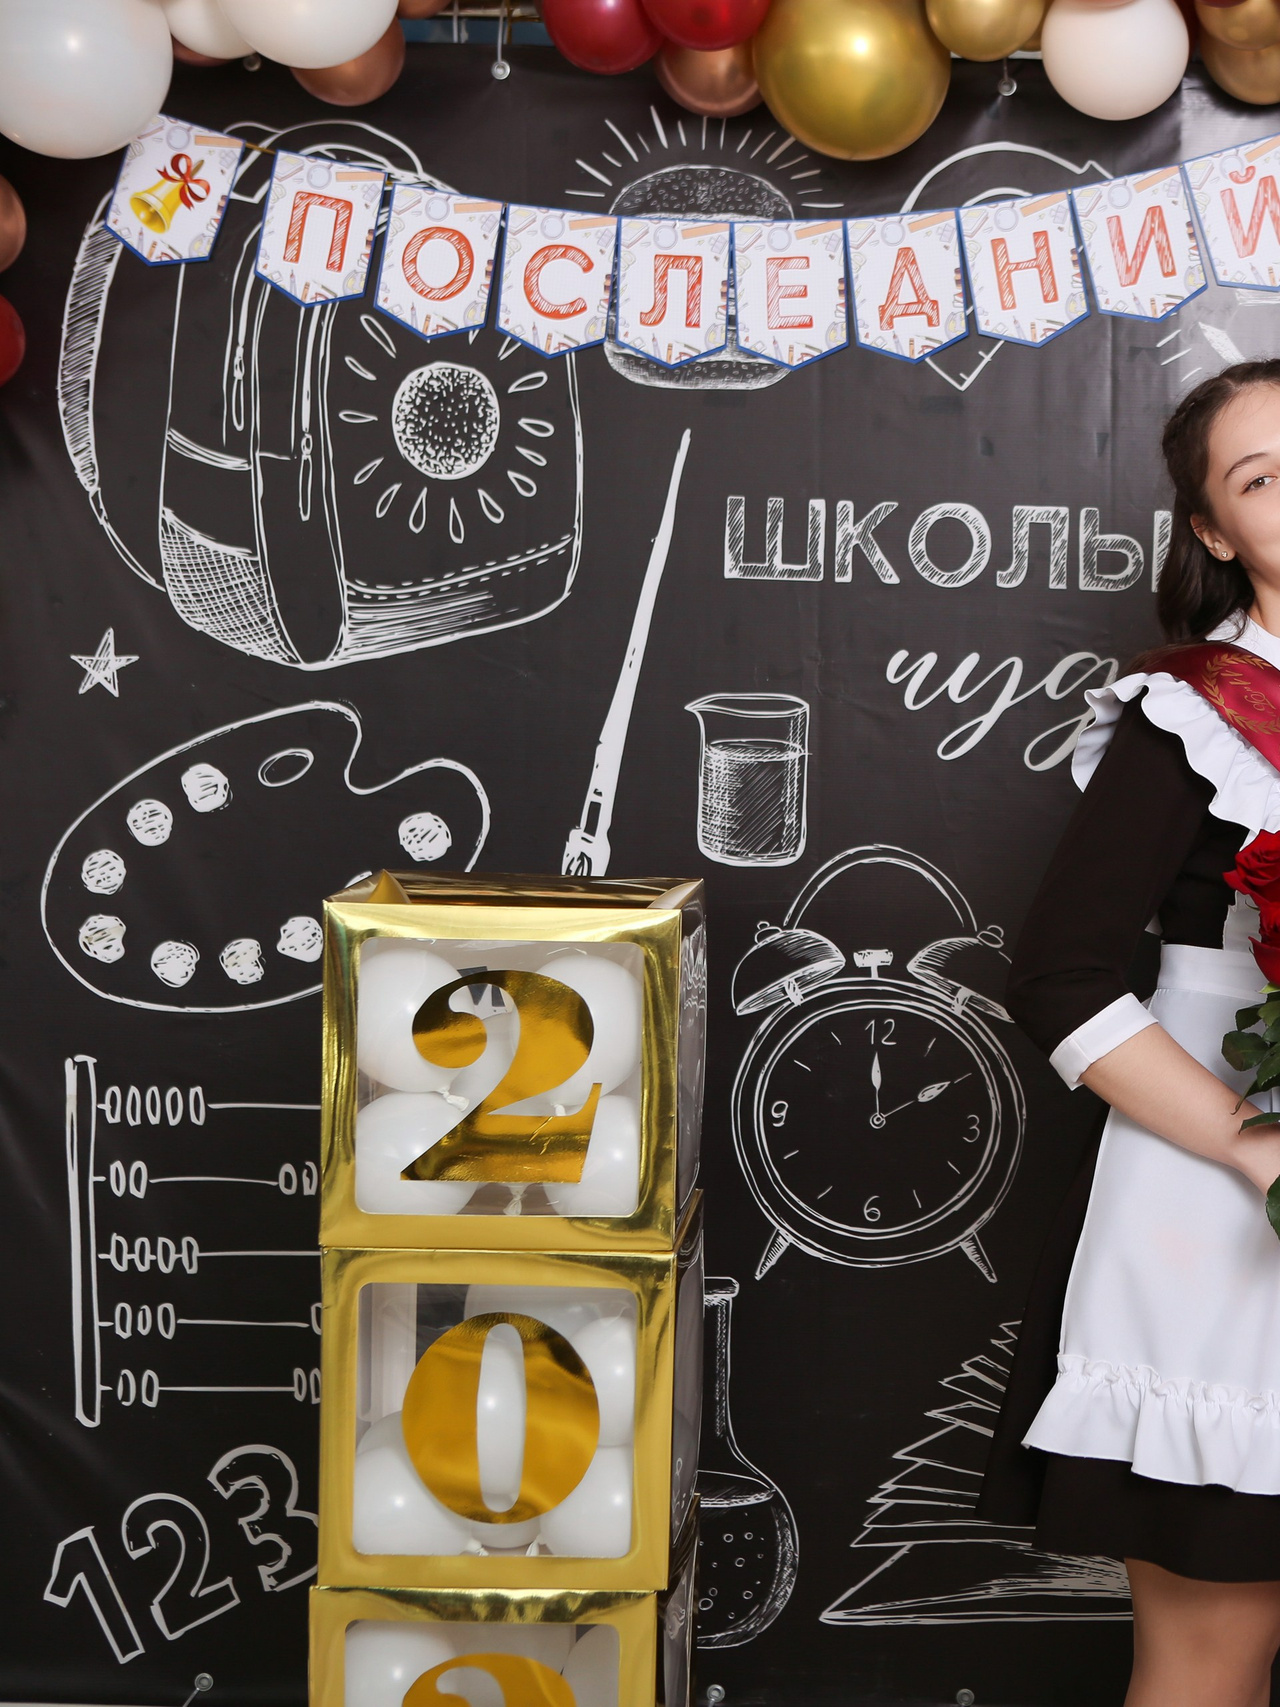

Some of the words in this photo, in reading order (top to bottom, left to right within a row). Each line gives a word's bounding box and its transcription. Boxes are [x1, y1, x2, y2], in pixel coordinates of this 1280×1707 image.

[864, 1019, 897, 1046] 12
[400, 970, 603, 1183] 2
[771, 1100, 789, 1127] 9
[962, 1114, 981, 1143] 3
[863, 1196, 882, 1222] 6
[402, 1311, 600, 1524] 0
